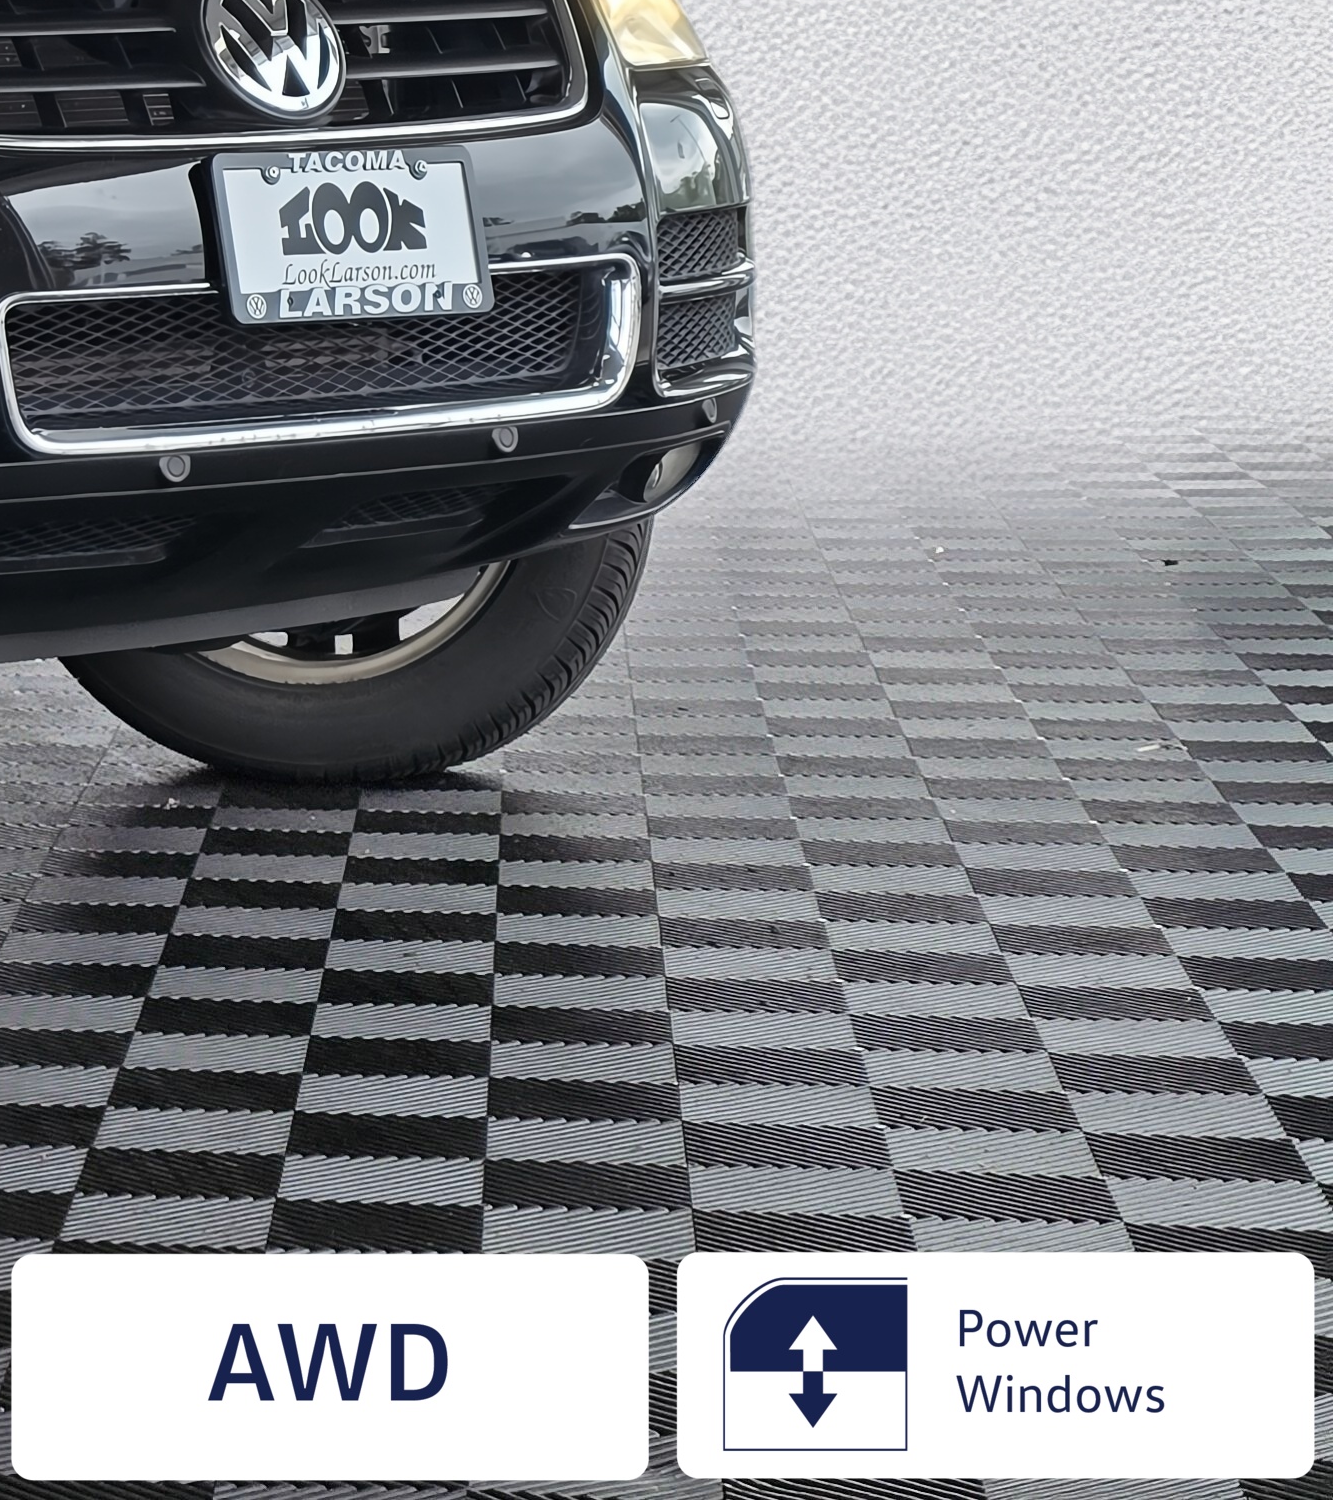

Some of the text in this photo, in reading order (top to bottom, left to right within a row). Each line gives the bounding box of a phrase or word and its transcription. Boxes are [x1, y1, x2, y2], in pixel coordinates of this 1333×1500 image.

[288, 149, 408, 174] TACOMA
[278, 181, 428, 255] LOOK
[282, 259, 437, 288] LookLarson.com
[279, 282, 453, 319] LARSON
